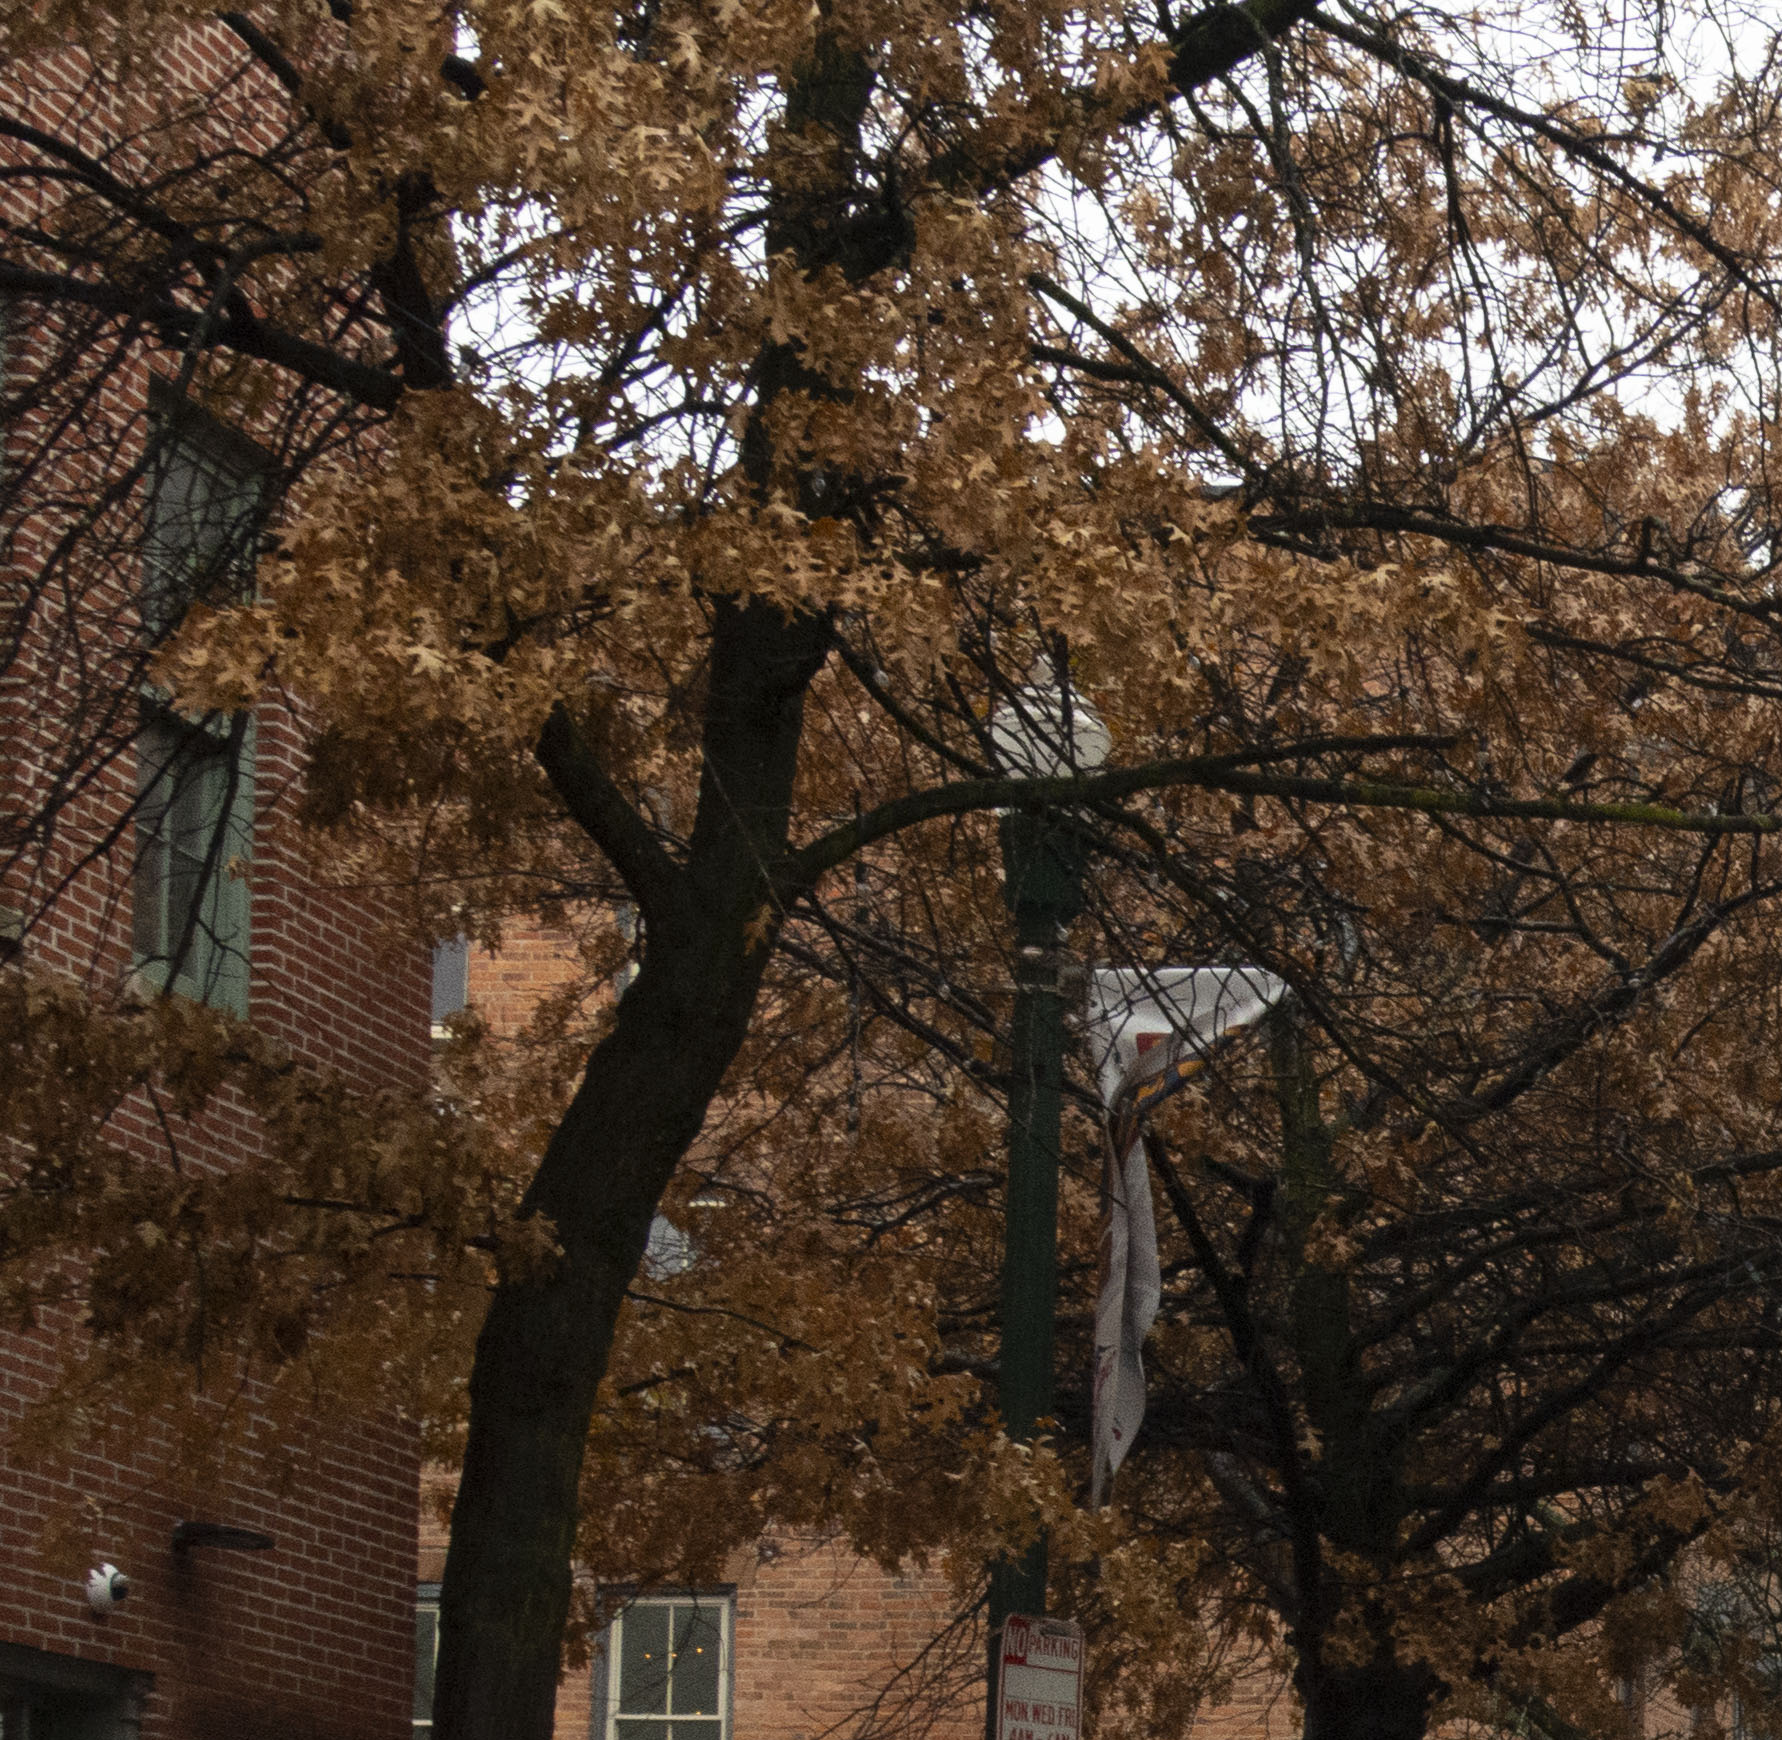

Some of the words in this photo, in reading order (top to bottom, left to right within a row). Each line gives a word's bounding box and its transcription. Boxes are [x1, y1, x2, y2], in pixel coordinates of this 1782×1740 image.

[1007, 1626, 1028, 1657] NO
[1029, 1634, 1079, 1661] PARKING
[1005, 1700, 1029, 1723] MON
[1032, 1703, 1055, 1726] WED
[1058, 1704, 1078, 1728] FRI
